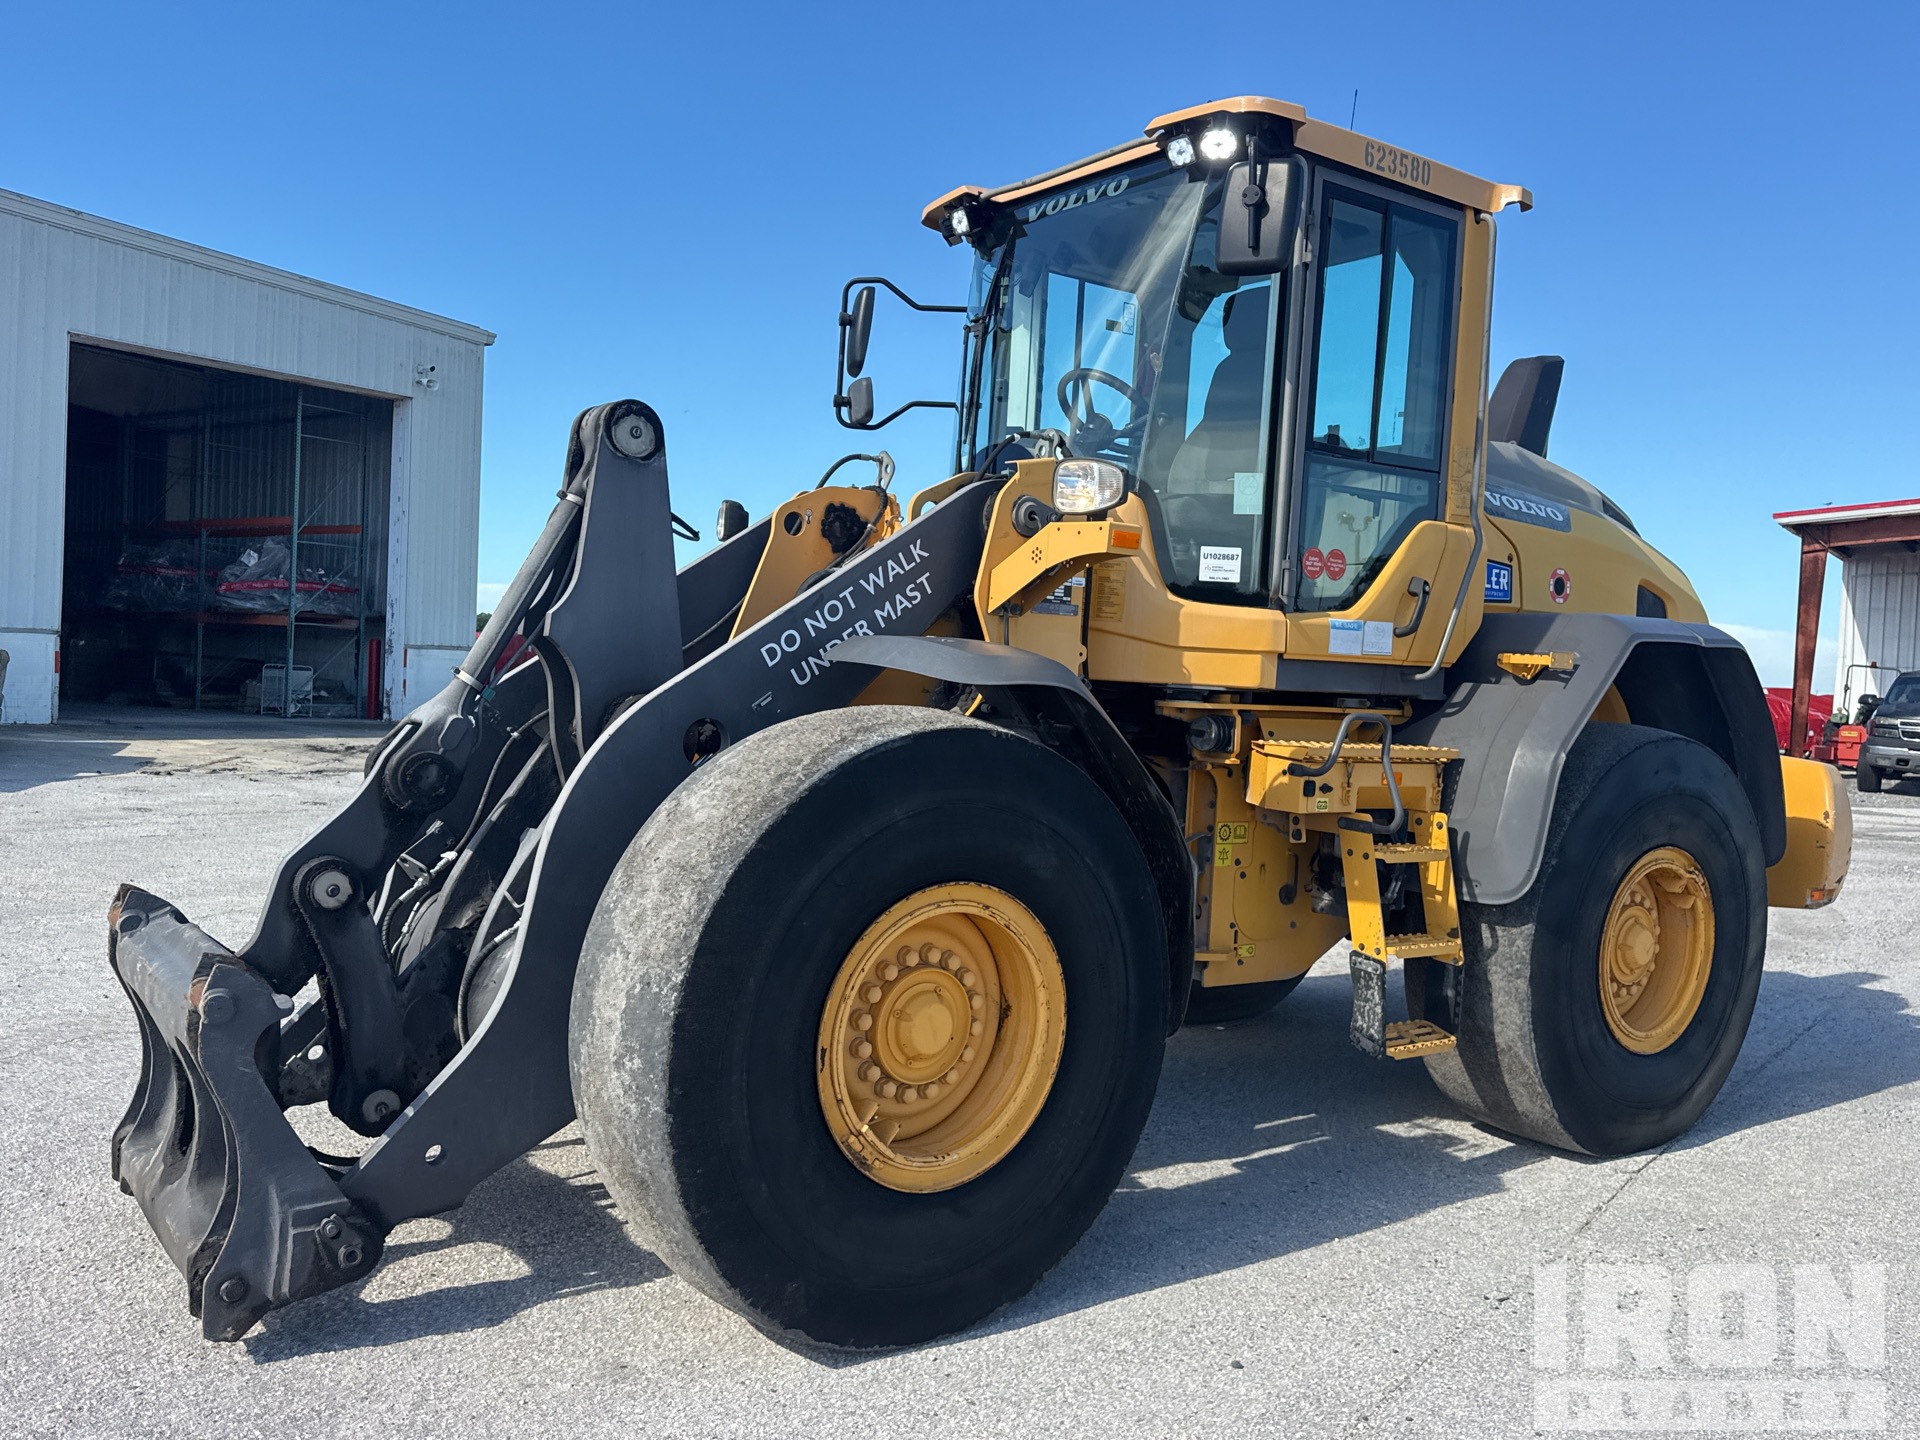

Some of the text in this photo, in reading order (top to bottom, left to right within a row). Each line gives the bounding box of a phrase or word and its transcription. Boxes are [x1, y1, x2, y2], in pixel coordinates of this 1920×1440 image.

[1364, 141, 1431, 186] 623580
[1028, 175, 1130, 222] VOLVO
[1484, 491, 1564, 522] VOLVO
[1203, 552, 1240, 561] U1028687
[760, 538, 929, 667] DO NOT WALK
[873, 572, 933, 628] MAST
